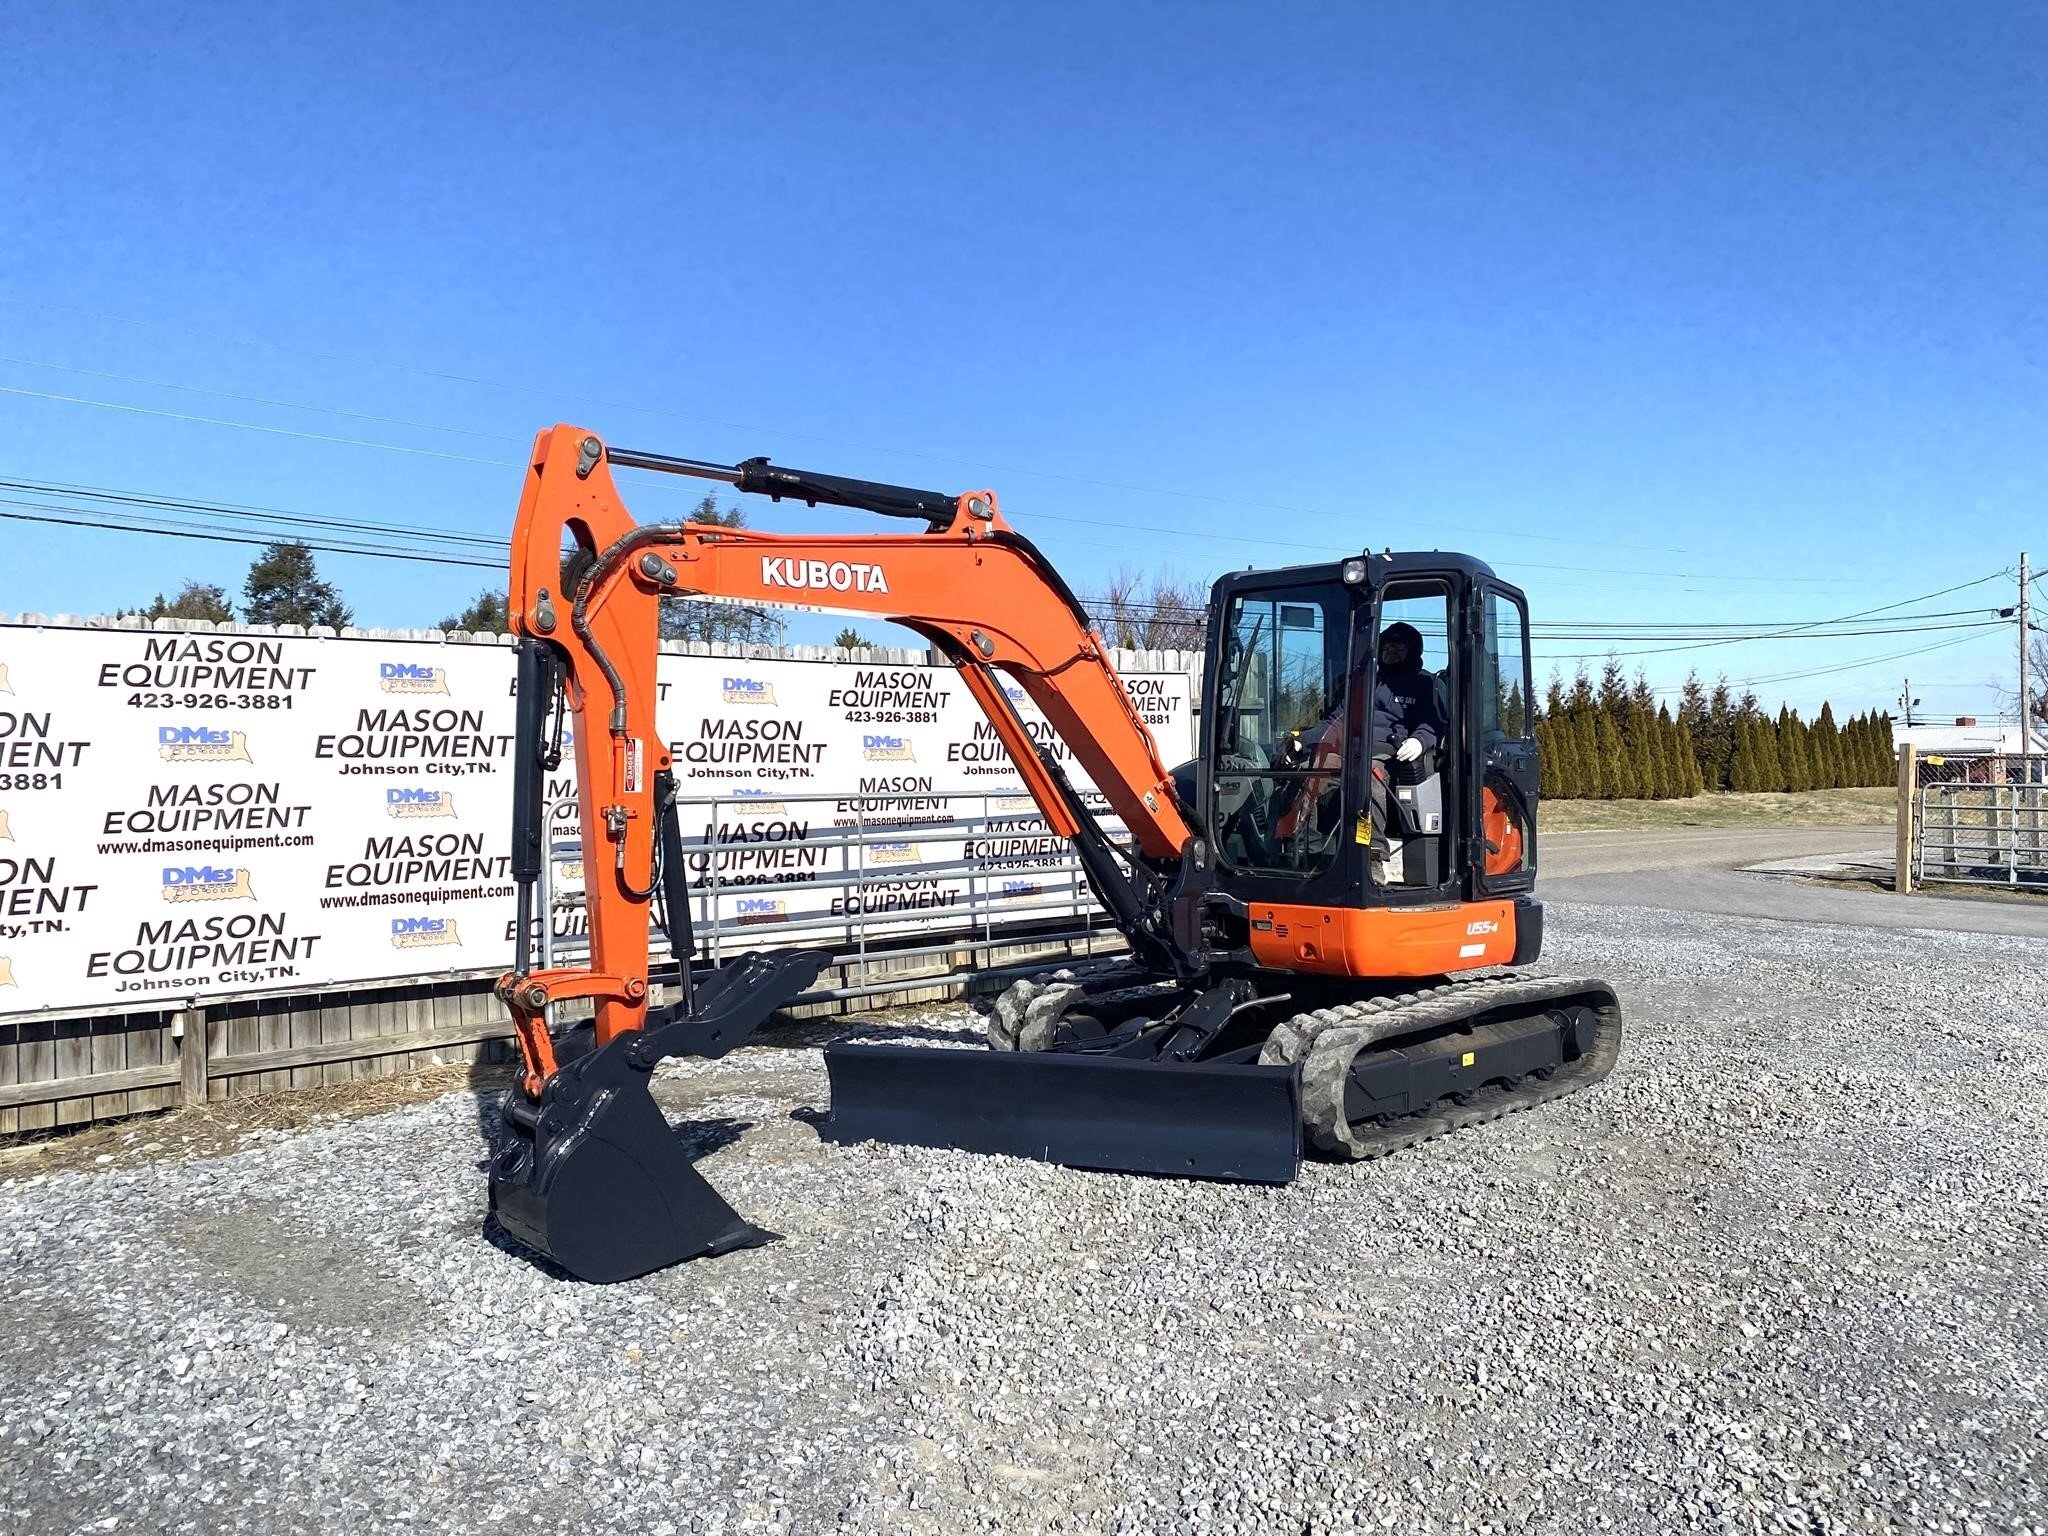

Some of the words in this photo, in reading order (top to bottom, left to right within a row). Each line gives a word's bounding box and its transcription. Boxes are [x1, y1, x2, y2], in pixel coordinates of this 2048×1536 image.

[761, 556, 889, 594] KUBOTA
[144, 638, 283, 665] MASON
[98, 663, 317, 691] EQUIPMENT
[854, 671, 933, 690] MASON
[127, 693, 294, 710] 423-926-3881
[828, 689, 951, 709] EQUIPMENT
[356, 708, 484, 732] MASON
[845, 711, 938, 723] 423-926-3881
[700, 718, 803, 741] MASON
[973, 721, 1056, 741] MON
[314, 735, 515, 759] EQUIPMENT
[670, 741, 828, 764] EQUIPMENT
[338, 763, 419, 776] Johnson
[425, 762, 497, 777] City,TN.
[687, 767, 752, 779] Johnson
[757, 767, 815, 780] City,TN.
[963, 765, 1016, 776] Johnson
[147, 783, 280, 808] MASON
[859, 776, 933, 794] MASON
[836, 797, 949, 813] EQUIPMENT
[103, 806, 312, 835] EQUIPMENT
[834, 814, 954, 828] www.masonequipment.com
[97, 834, 314, 856] www.dmasonequipment.com
[703, 821, 809, 845] MASON
[364, 833, 484, 860] MASON
[964, 838, 1072, 860] EQUIPMENT
[688, 847, 829, 872] QUIPMENT
[325, 857, 511, 888] EQUIPMENT
[319, 884, 515, 909] www.dmasonequipment.com
[830, 889, 960, 916] EQUIPMENT
[136, 912, 286, 946] MASON
[86, 935, 322, 979] EQUIPMENT
[115, 974, 211, 993] Johnson
[218, 965, 301, 984] City,TN.
